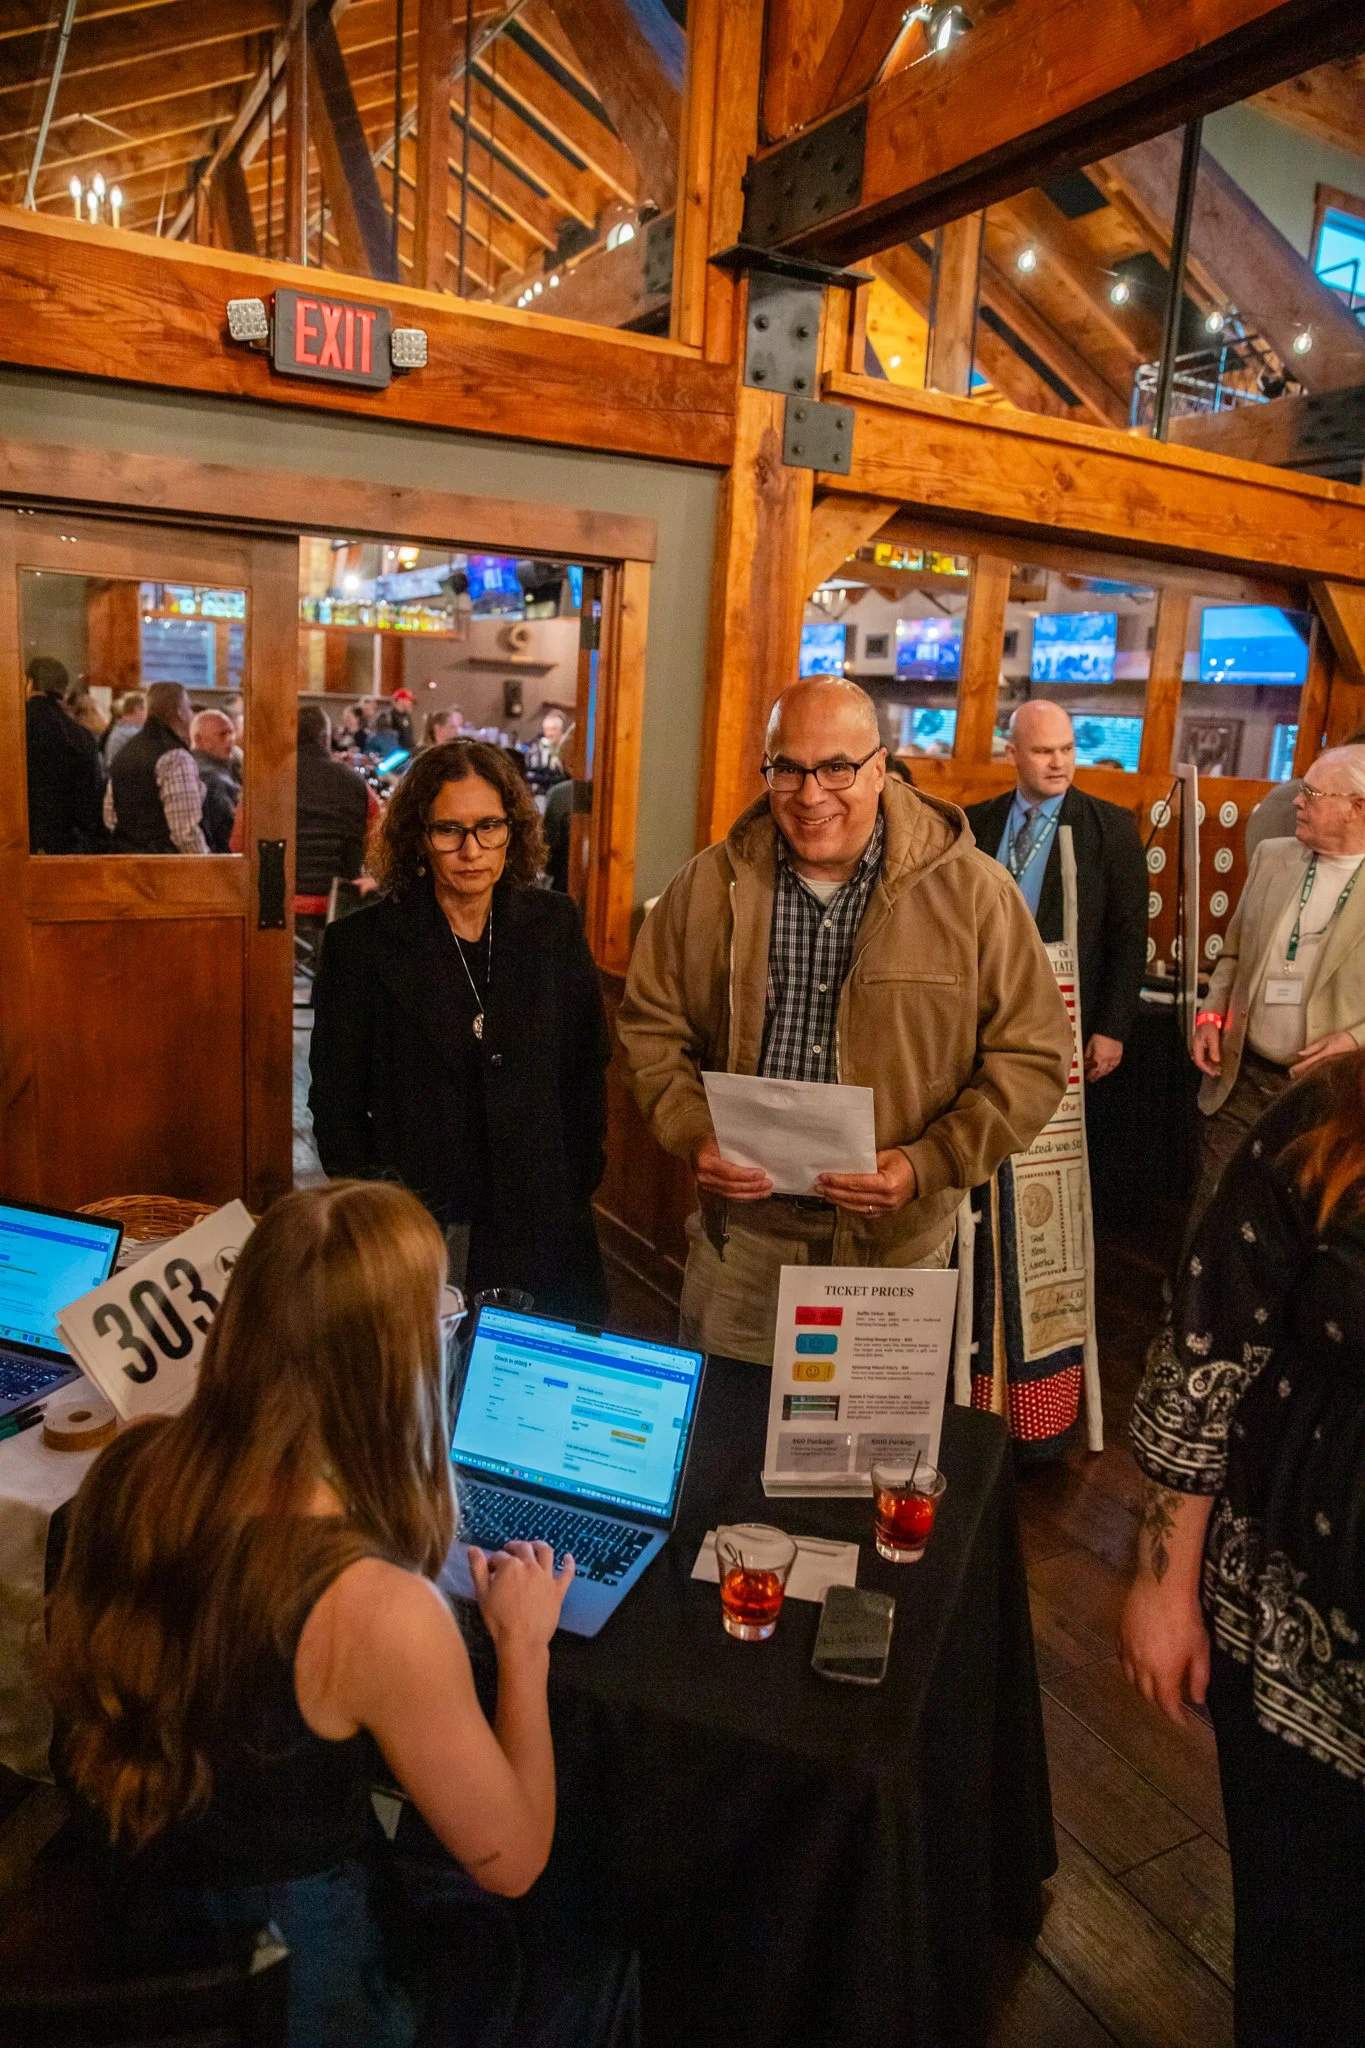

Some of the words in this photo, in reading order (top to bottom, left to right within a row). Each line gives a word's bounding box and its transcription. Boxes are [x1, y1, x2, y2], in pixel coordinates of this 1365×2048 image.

[295, 297, 377, 374] EXIT
[1055, 1143, 1070, 1152] we
[1030, 1232, 1045, 1243] God
[1029, 1258, 1056, 1270] America
[824, 1285, 869, 1297] TICKET
[871, 1286, 914, 1298] PRICES
[92, 1257, 220, 1384] 303
[494, 1354, 508, 1363] Check
[807, 1438, 835, 1446] Package
[888, 1439, 917, 1447] Package
